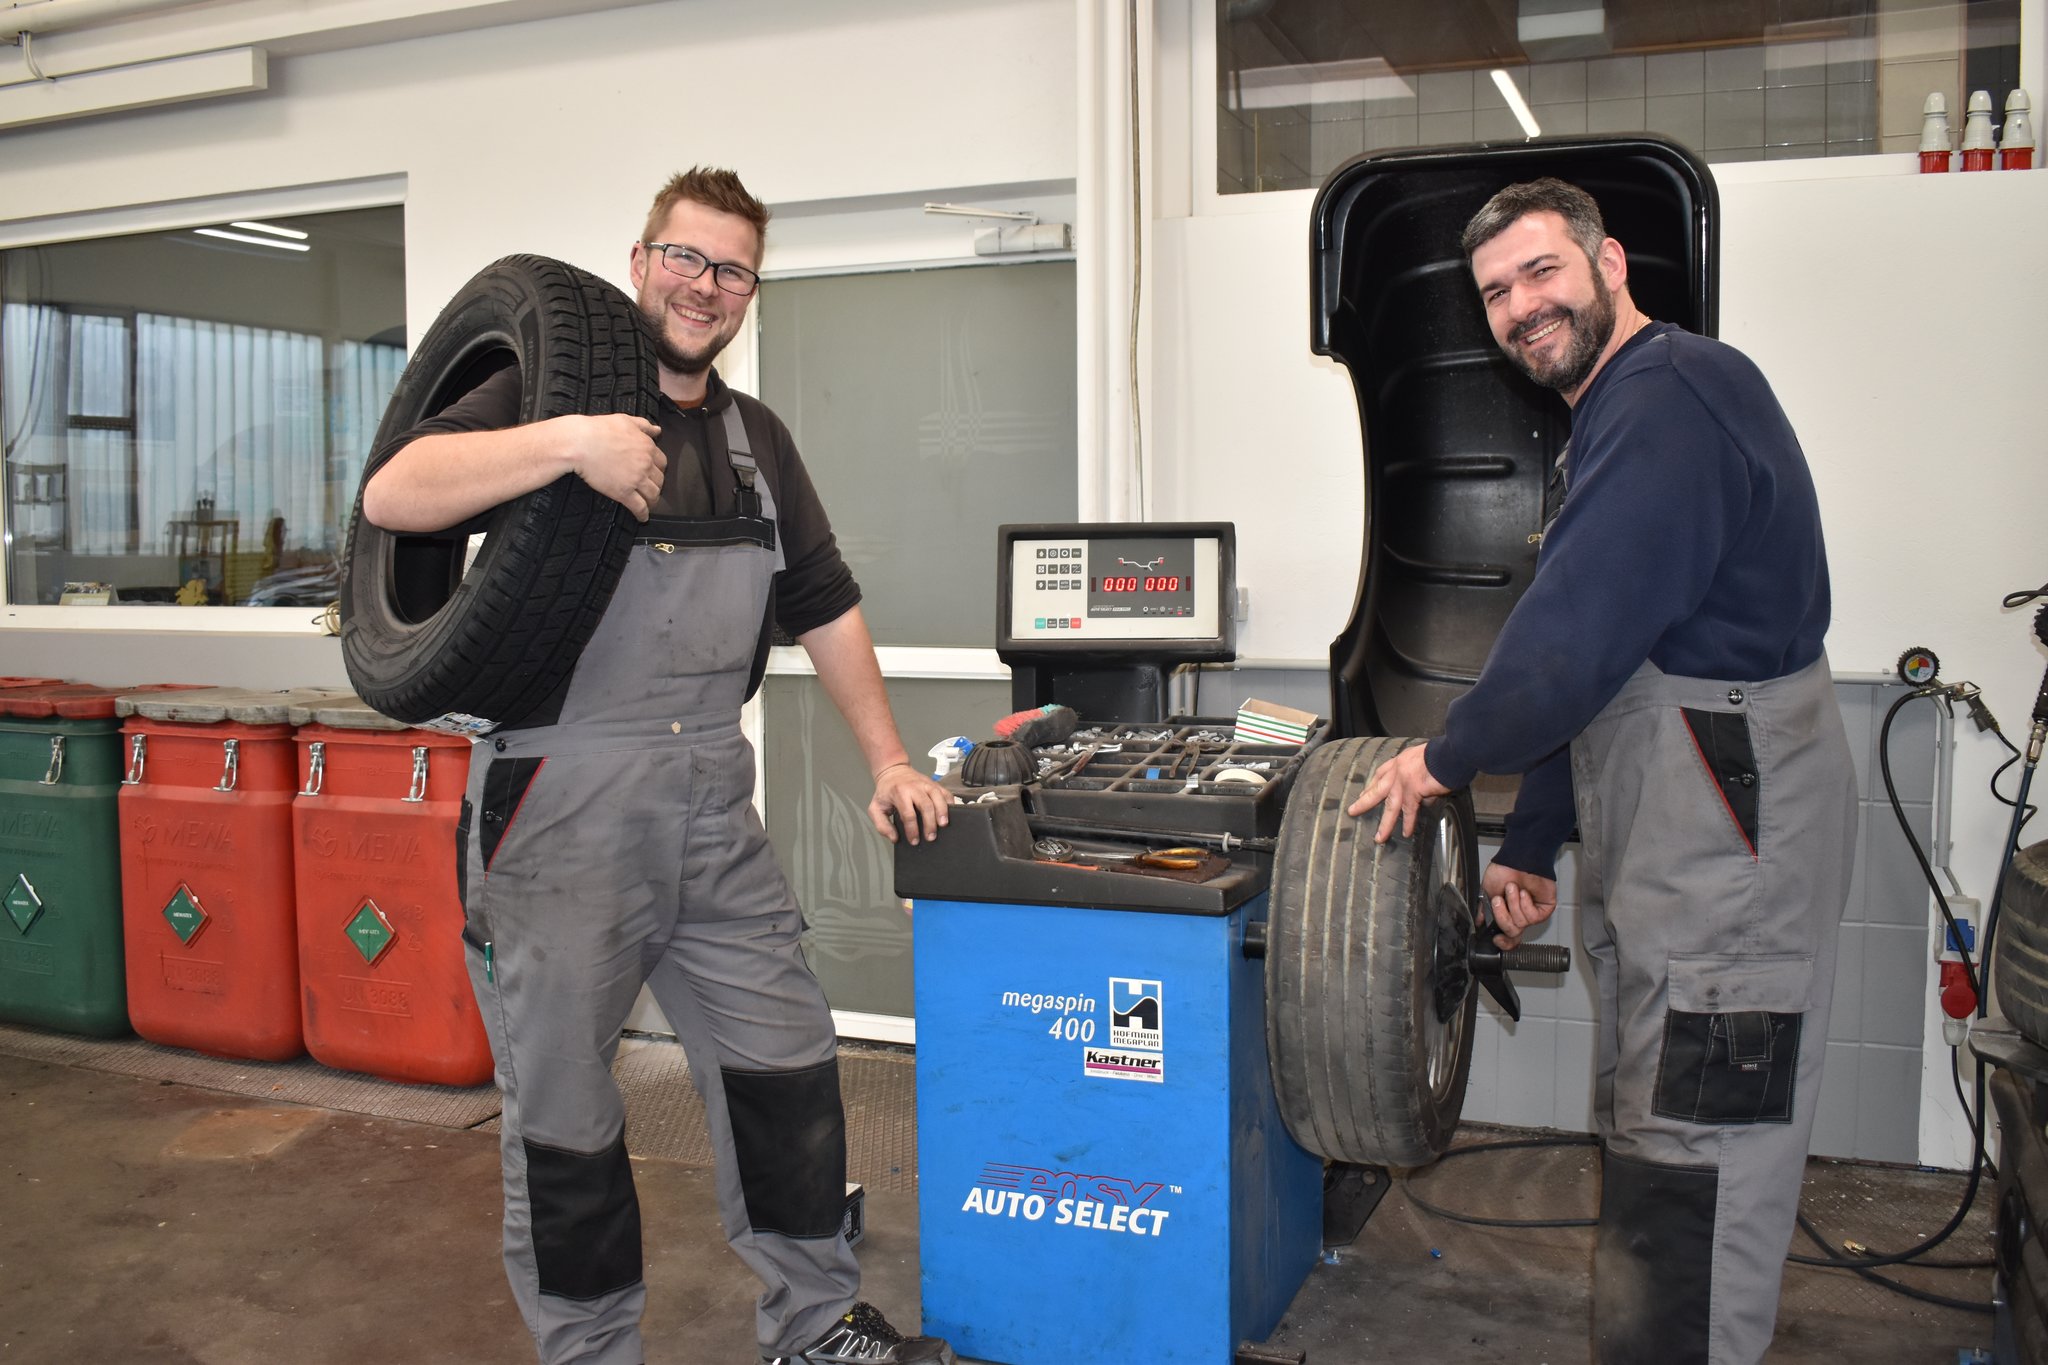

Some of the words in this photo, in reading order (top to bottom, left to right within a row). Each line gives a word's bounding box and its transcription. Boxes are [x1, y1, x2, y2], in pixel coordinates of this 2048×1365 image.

[1103, 577, 1137, 592] 000
[1144, 577, 1178, 592] 000
[164, 818, 236, 851] MEWA
[344, 830, 424, 865] MEWA
[1002, 990, 1095, 1016] megaspin
[1048, 1017, 1095, 1042] 400
[1113, 1030, 1159, 1041] HOFMANN
[1113, 1037, 1160, 1047] MEGAPLAN
[1086, 1050, 1161, 1069] Kastner
[961, 1187, 1046, 1221] AUTO
[1055, 1198, 1170, 1237] SELECT
